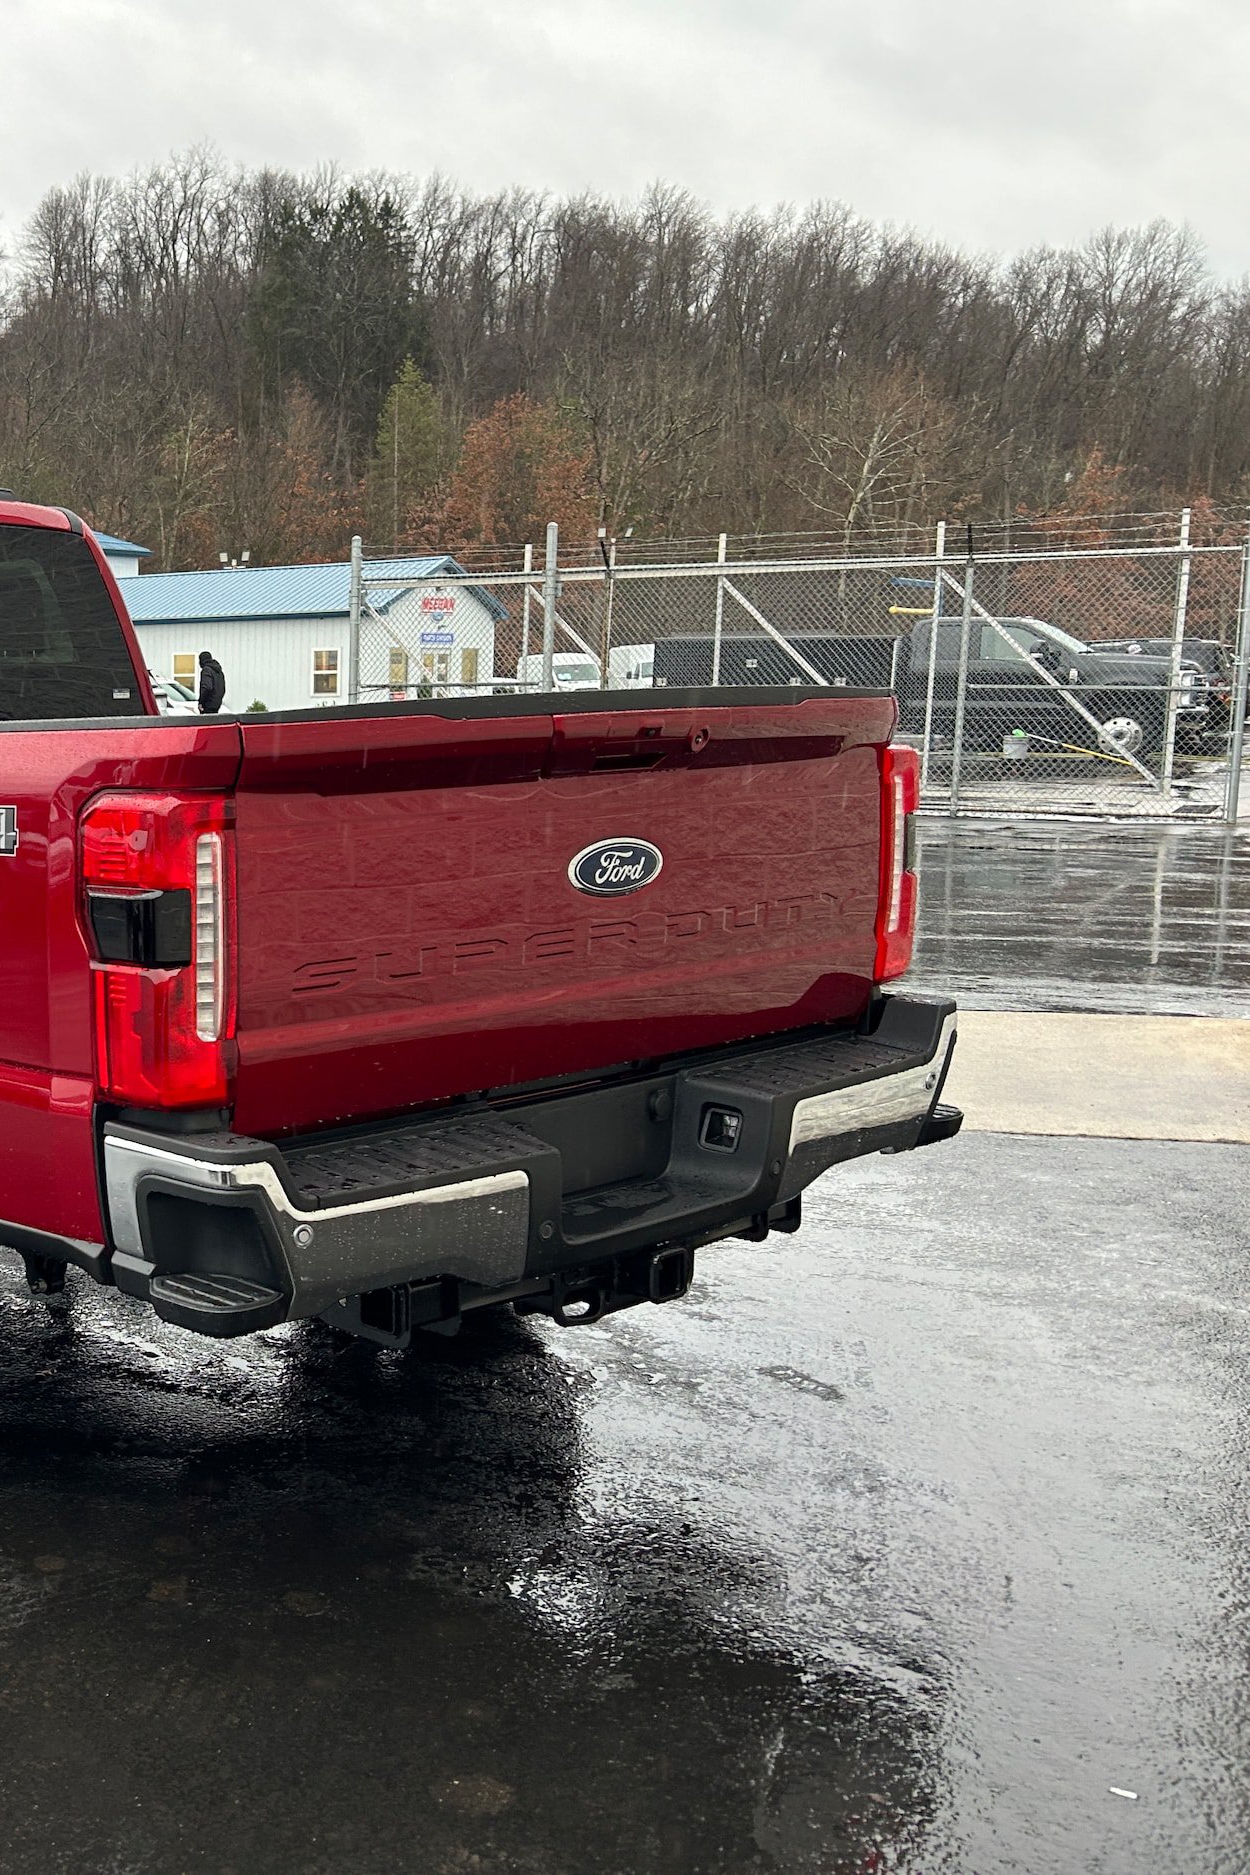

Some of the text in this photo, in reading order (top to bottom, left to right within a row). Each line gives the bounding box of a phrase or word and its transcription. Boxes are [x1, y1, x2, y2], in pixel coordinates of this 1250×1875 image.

[595, 850, 647, 885] Ford
[291, 892, 850, 999] SUPER DUTY
